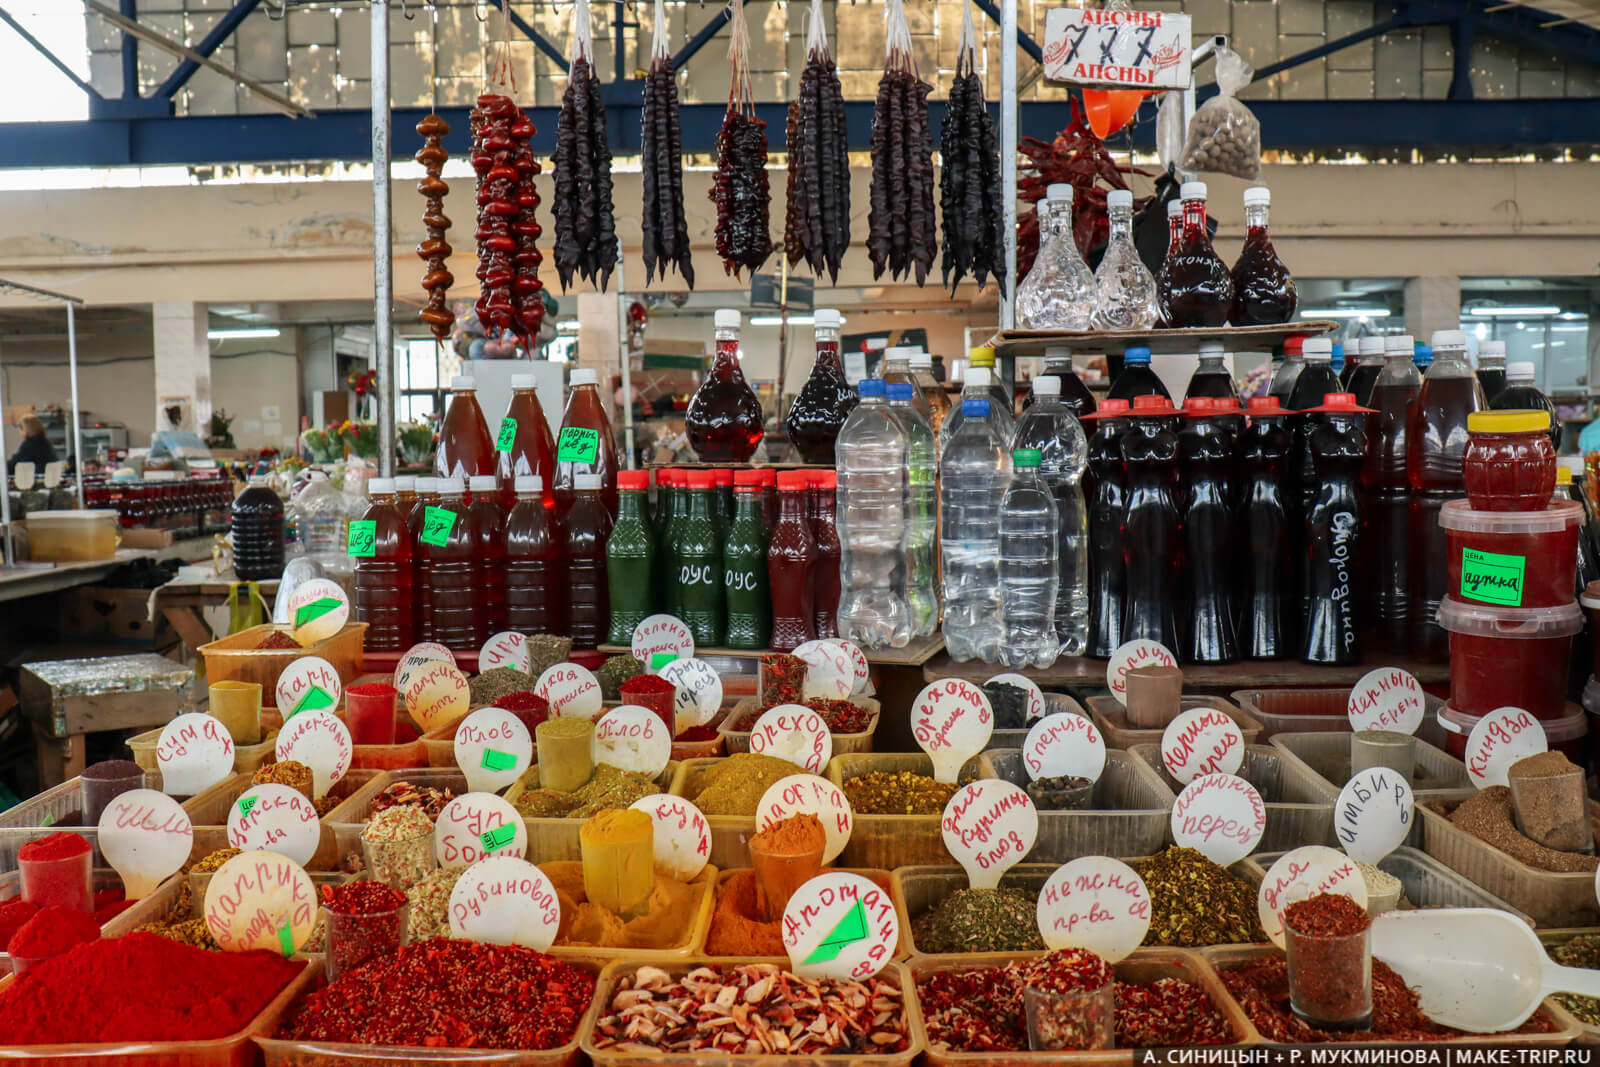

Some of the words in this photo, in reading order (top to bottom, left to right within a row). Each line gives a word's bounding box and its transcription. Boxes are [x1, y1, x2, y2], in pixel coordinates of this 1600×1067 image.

[1081, 10, 1162, 27] АПСНЫ
[1073, 63, 1154, 83] АПСНЫ
[1464, 552, 1484, 561] ЦЕНА
